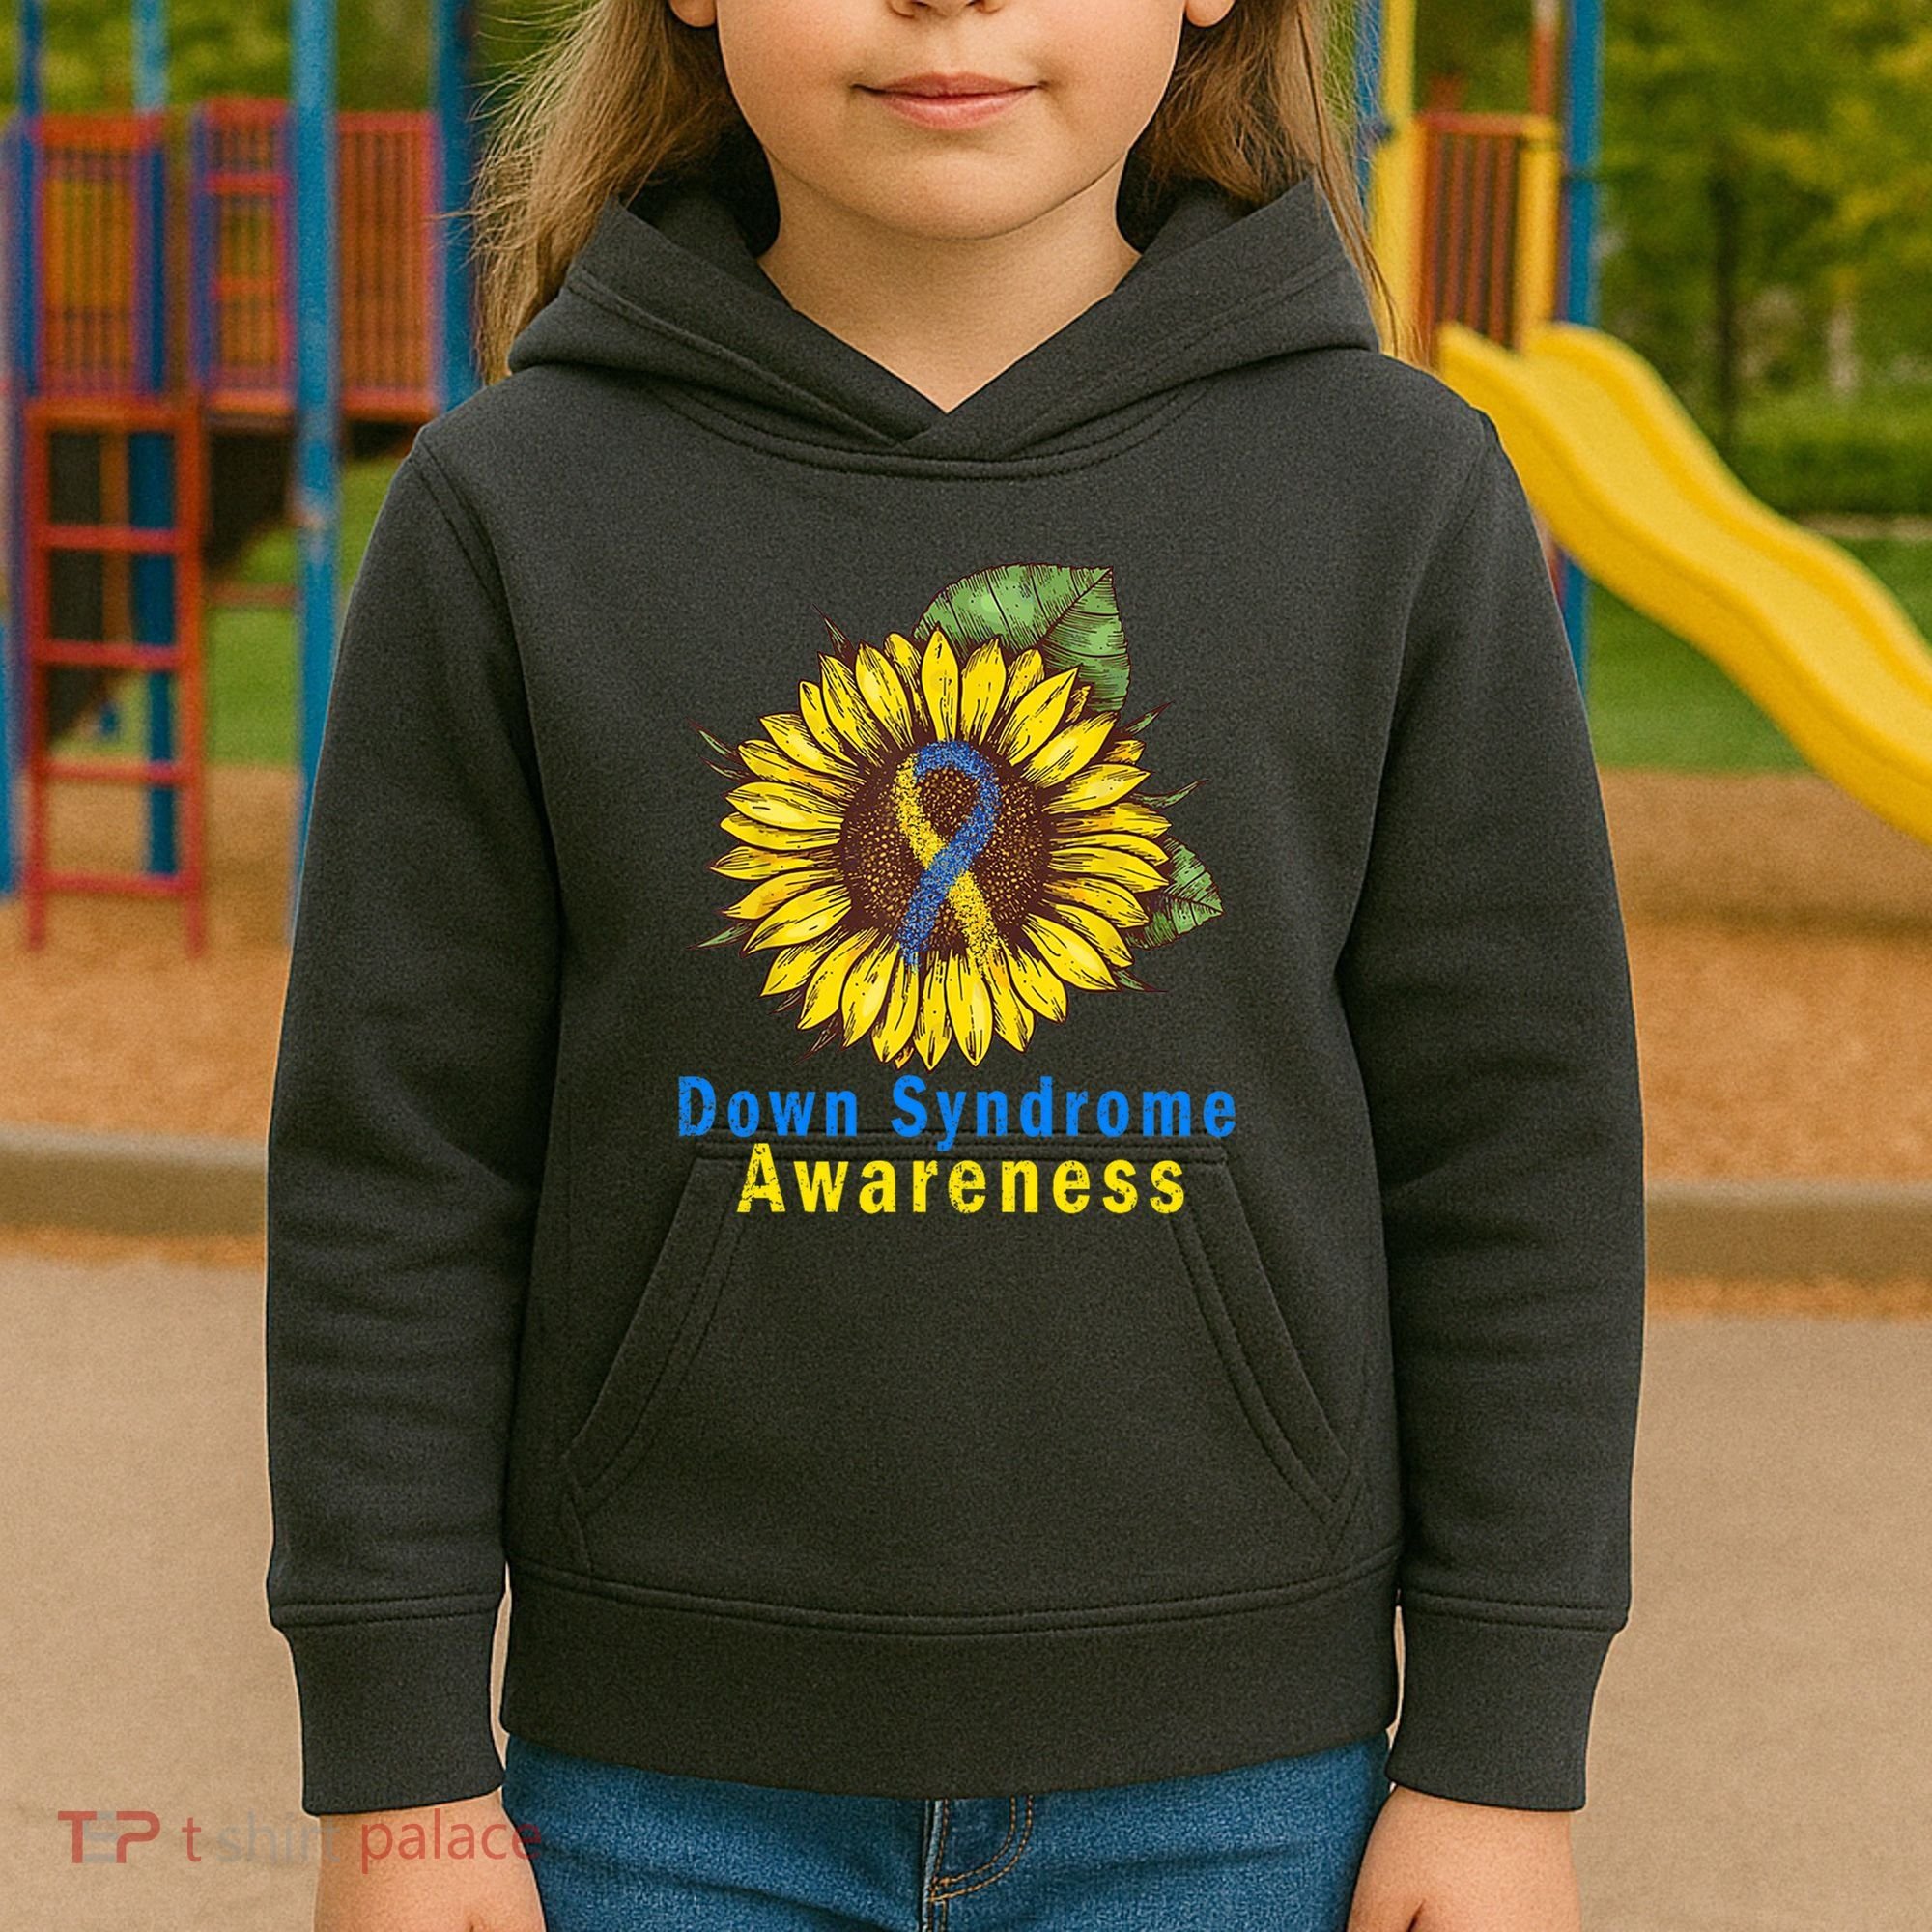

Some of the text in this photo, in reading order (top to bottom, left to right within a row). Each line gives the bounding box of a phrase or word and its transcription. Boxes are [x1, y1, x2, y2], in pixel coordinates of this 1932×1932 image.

[678, 1074, 1236, 1152] Down Syndrome
[736, 1143, 1185, 1214] Awareness
